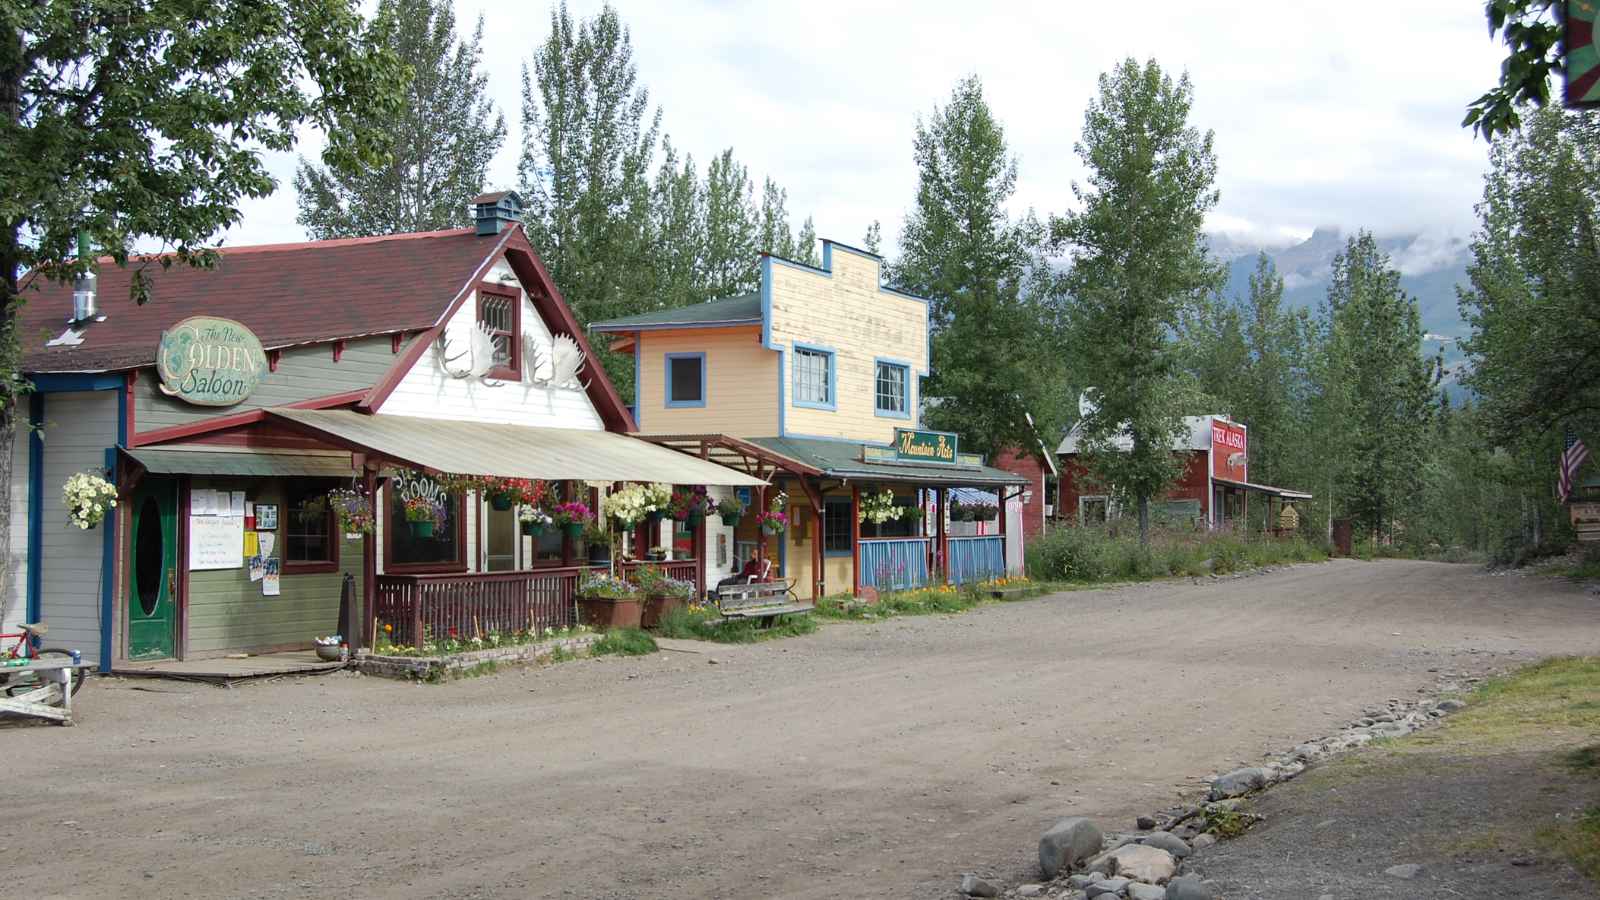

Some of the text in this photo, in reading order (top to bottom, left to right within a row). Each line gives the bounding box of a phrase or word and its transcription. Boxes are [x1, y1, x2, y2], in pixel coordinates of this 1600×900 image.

[204, 327, 220, 341] The
[163, 325, 256, 378] GOLDEN
[181, 368, 246, 395] Saloon
[899, 432, 935, 457] Mountain
[937, 435, 953, 459] Arts
[1214, 427, 1243, 448] TREK ALASKA
